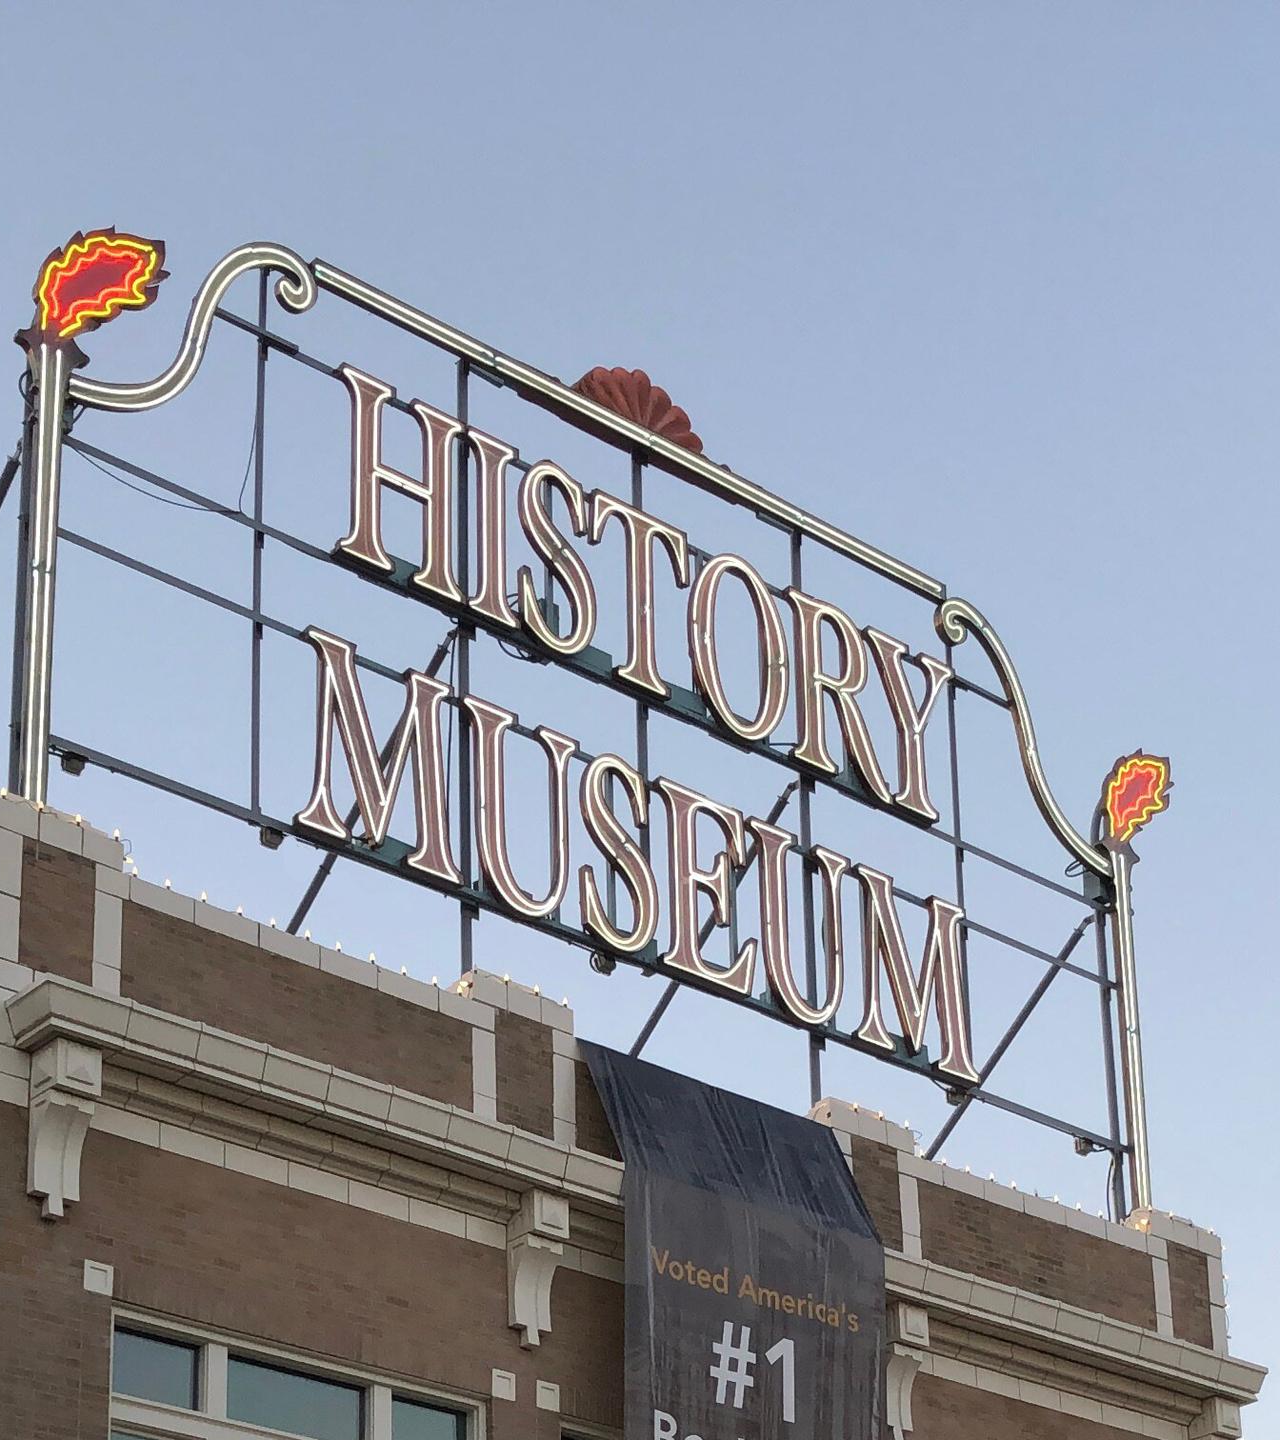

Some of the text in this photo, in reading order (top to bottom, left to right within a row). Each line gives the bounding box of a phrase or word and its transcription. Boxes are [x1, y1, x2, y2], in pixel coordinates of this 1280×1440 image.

[331, 364, 953, 827] HISTORY
[295, 626, 982, 1084] MUSEUM
[650, 1247, 860, 1333] Voted America's
[710, 1320, 796, 1424] #1
